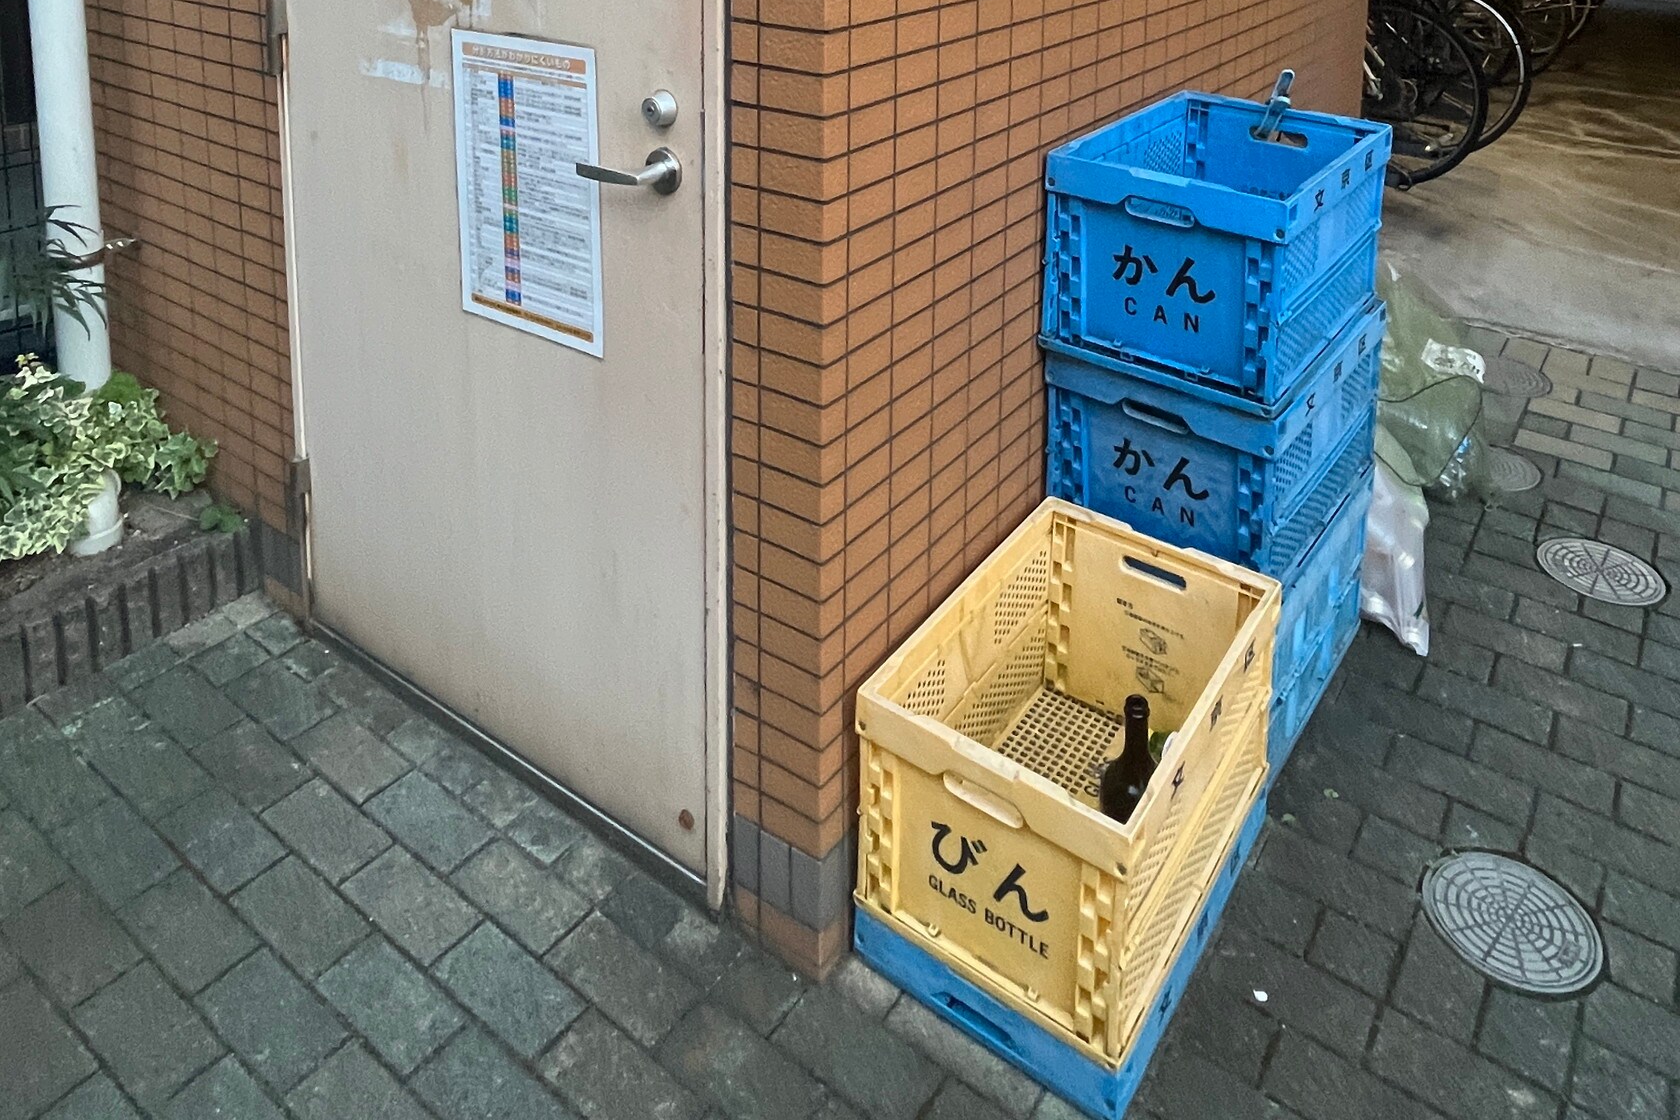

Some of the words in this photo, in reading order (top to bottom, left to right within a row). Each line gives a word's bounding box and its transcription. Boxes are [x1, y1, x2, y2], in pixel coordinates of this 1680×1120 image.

[1314, 149, 1374, 212] 文京区
[1112, 244, 1216, 304] かん
[1124, 296, 1200, 333] CAN
[1305, 333, 1367, 416] 文京区
[1113, 437, 1209, 500] かん
[1124, 485, 1195, 527] CAN
[931, 821, 1049, 922] びん
[928, 874, 976, 914] GLASS
[984, 907, 1049, 959] BOTTLE
